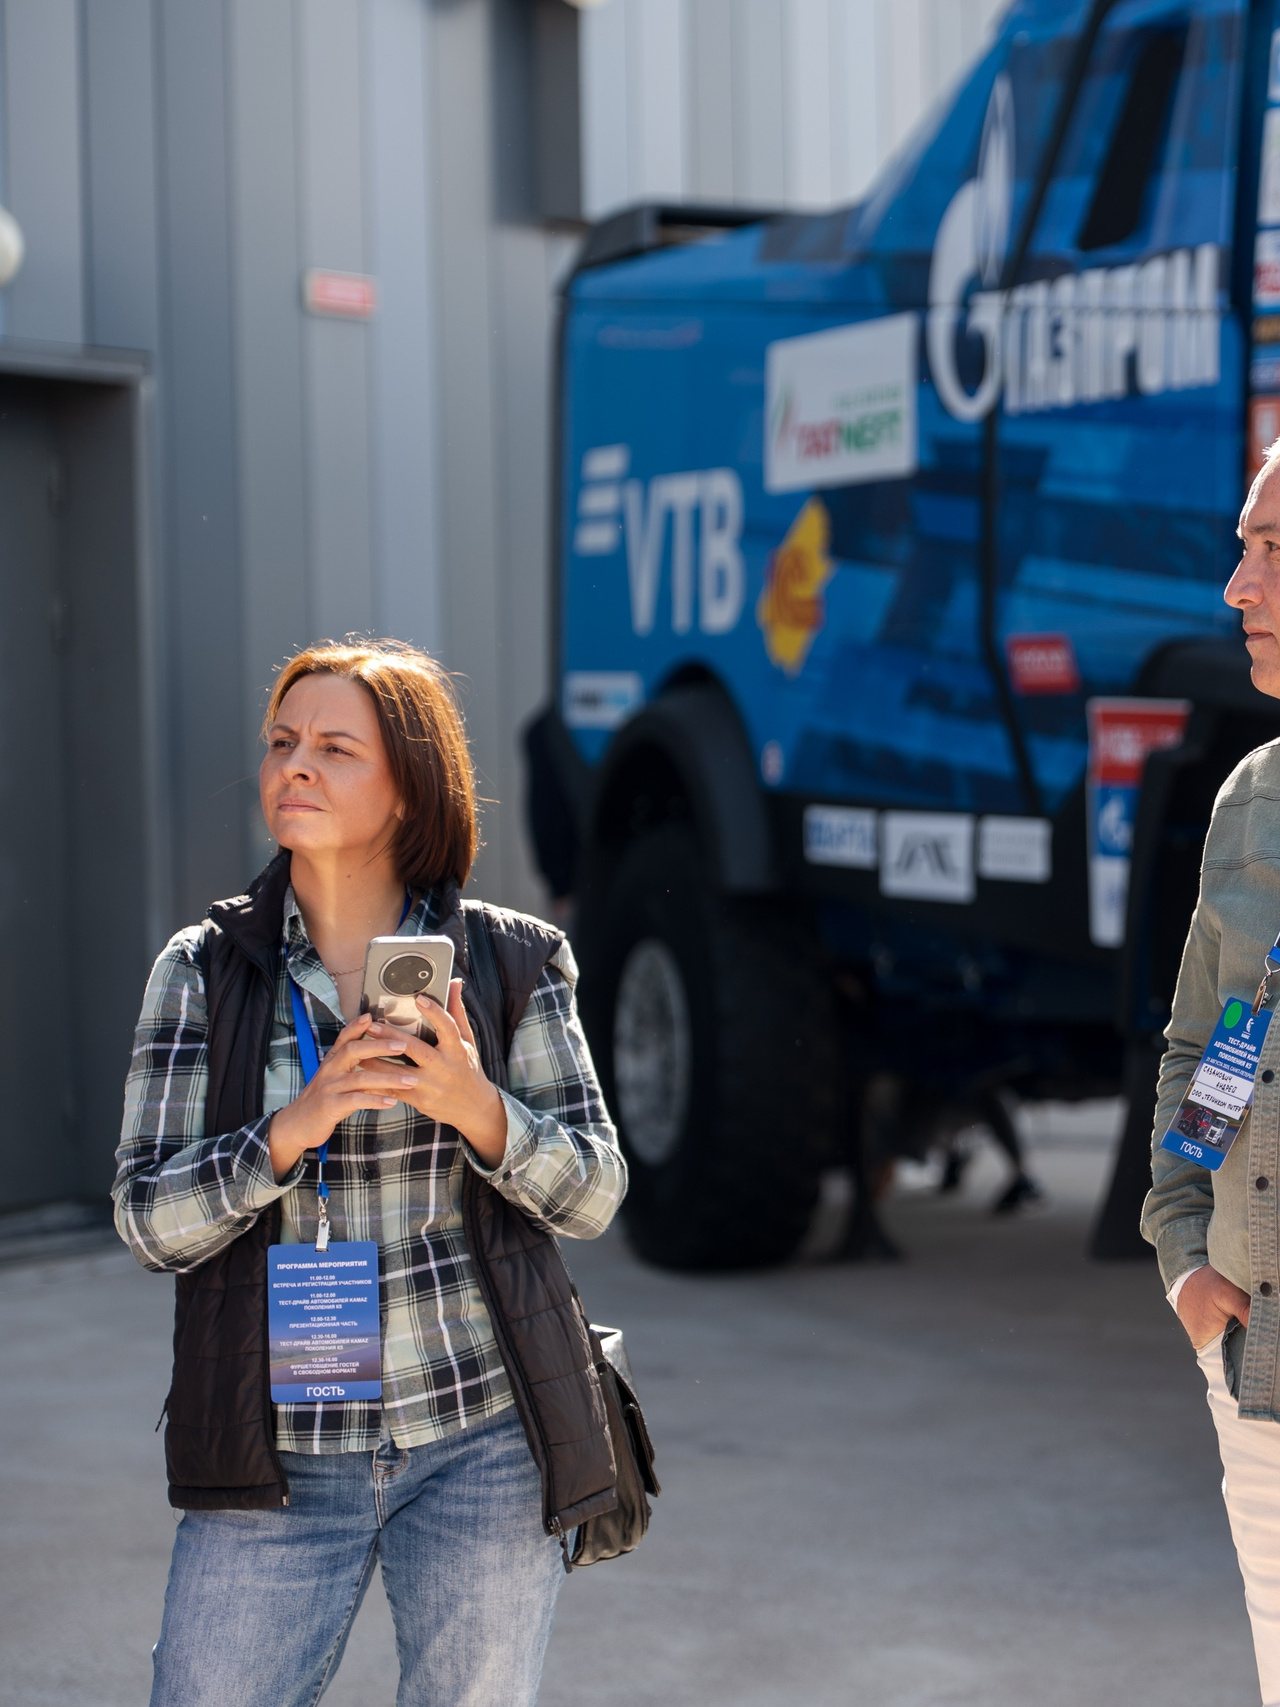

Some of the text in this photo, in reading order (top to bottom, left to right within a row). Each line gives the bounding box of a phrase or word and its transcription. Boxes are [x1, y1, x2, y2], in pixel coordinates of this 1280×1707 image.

[1213, 1041, 1248, 1058] АВТОМОБИЛЕЙ
[1228, 1036, 1256, 1052] ТЕСТ-ДРАЙВ
[1180, 1141, 1203, 1159] ГОСТЬ
[277, 1260, 367, 1270] ПРОГРАММА МЕРОПРИЯТИЯ
[339, 1360, 360, 1368] ГОСТЕЙ
[306, 1385, 346, 1397] ГОСТЬ
